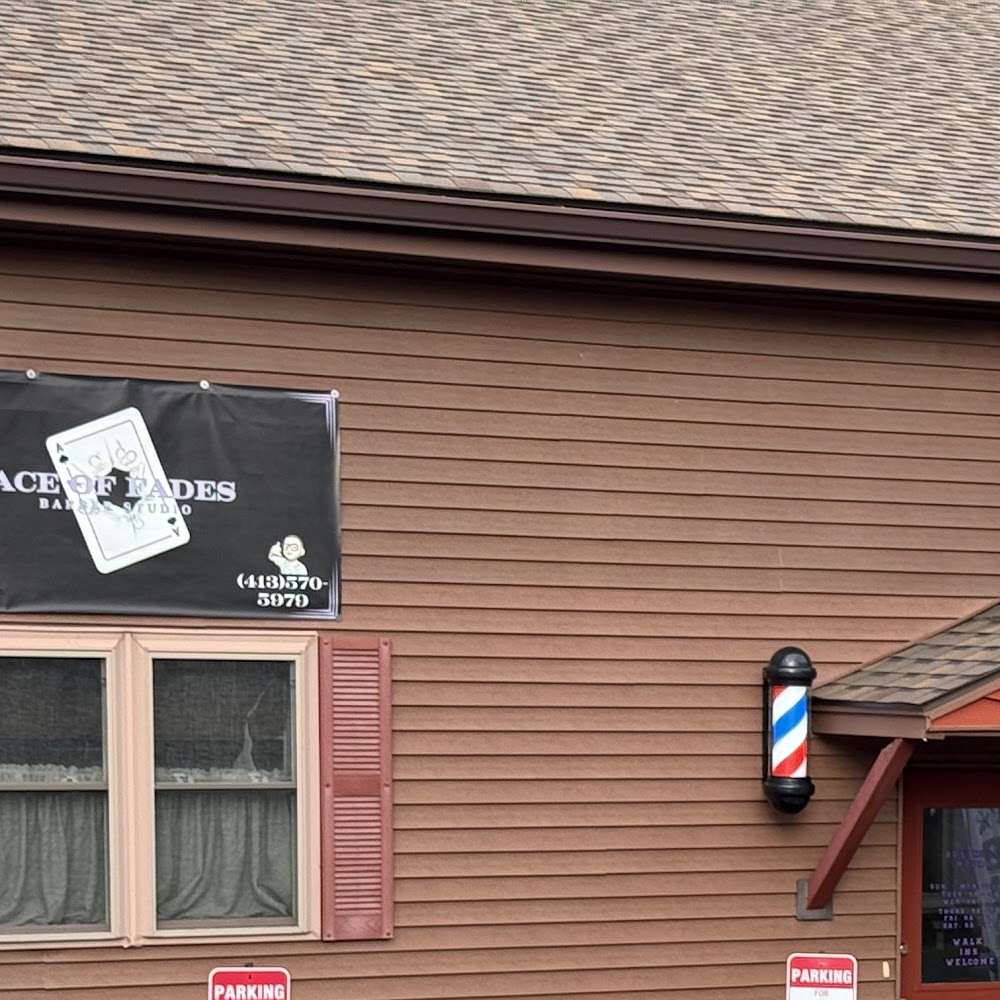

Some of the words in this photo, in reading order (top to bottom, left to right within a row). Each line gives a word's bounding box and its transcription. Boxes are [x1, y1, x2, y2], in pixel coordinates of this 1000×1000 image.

[0, 470, 61, 494] ACE
[68, 475, 117, 497] OF
[125, 476, 237, 502] FADES
[123, 501, 192, 516] STUDIO
[952, 937, 982, 946] WALK
[959, 947, 978, 956] INS
[945, 957, 995, 967] WELCOME
[791, 968, 852, 984] PARKING
[214, 984, 285, 1000] PARKING
